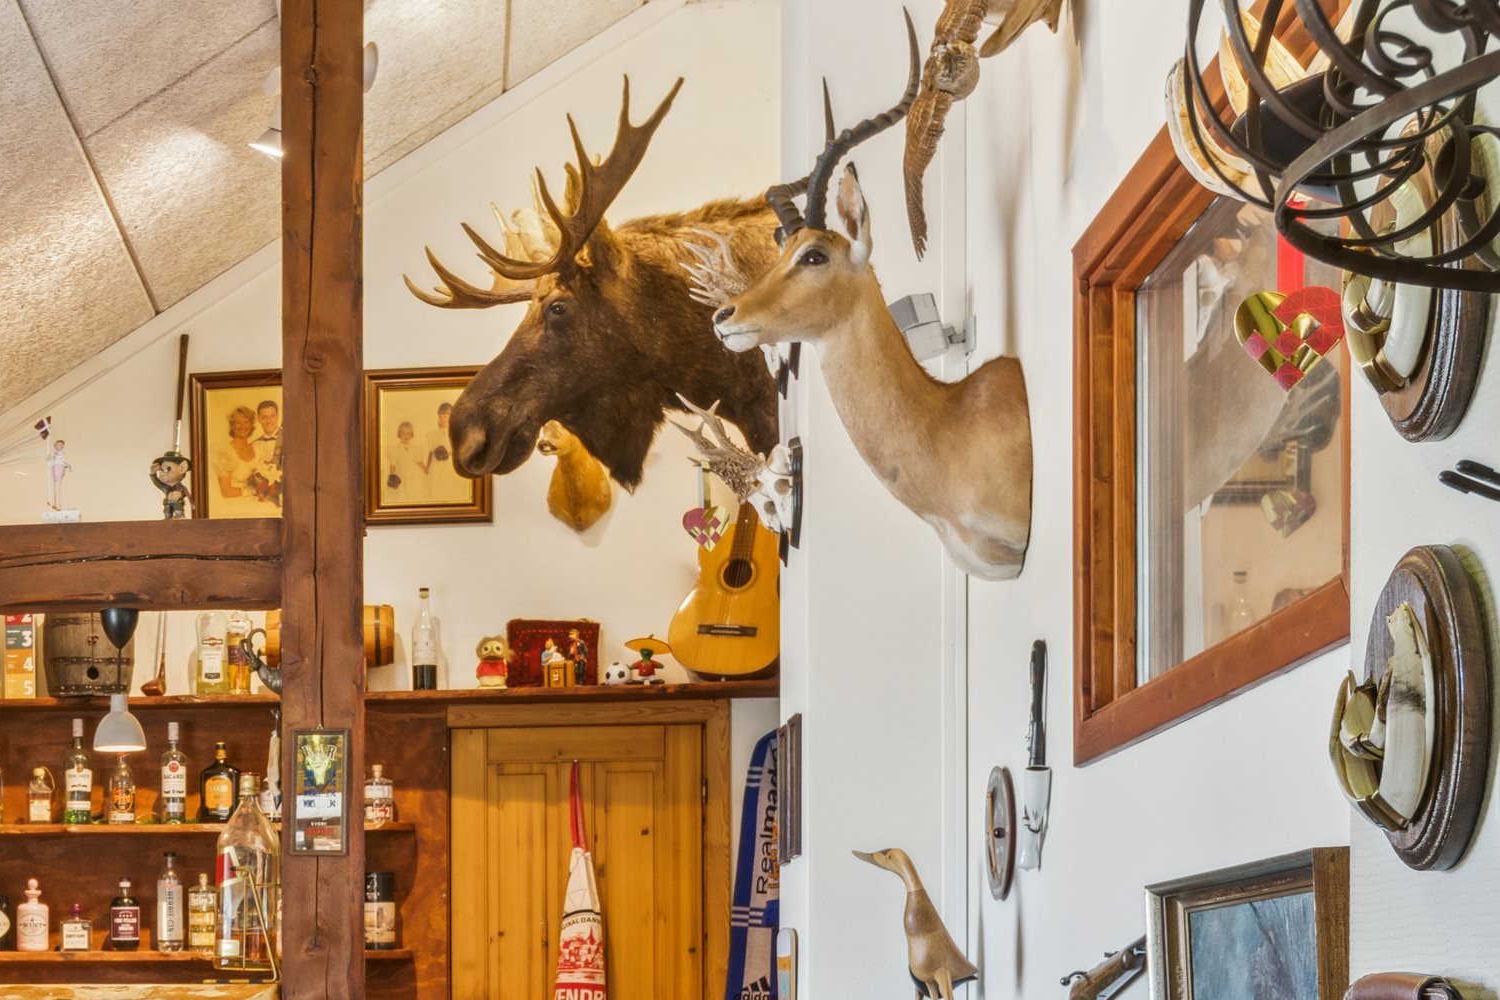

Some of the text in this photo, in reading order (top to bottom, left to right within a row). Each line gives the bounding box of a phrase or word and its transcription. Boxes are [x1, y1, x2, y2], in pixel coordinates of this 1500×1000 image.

[22, 630, 32, 647] 3
[23, 657, 34, 671] 4
[23, 680, 33, 696] 5
